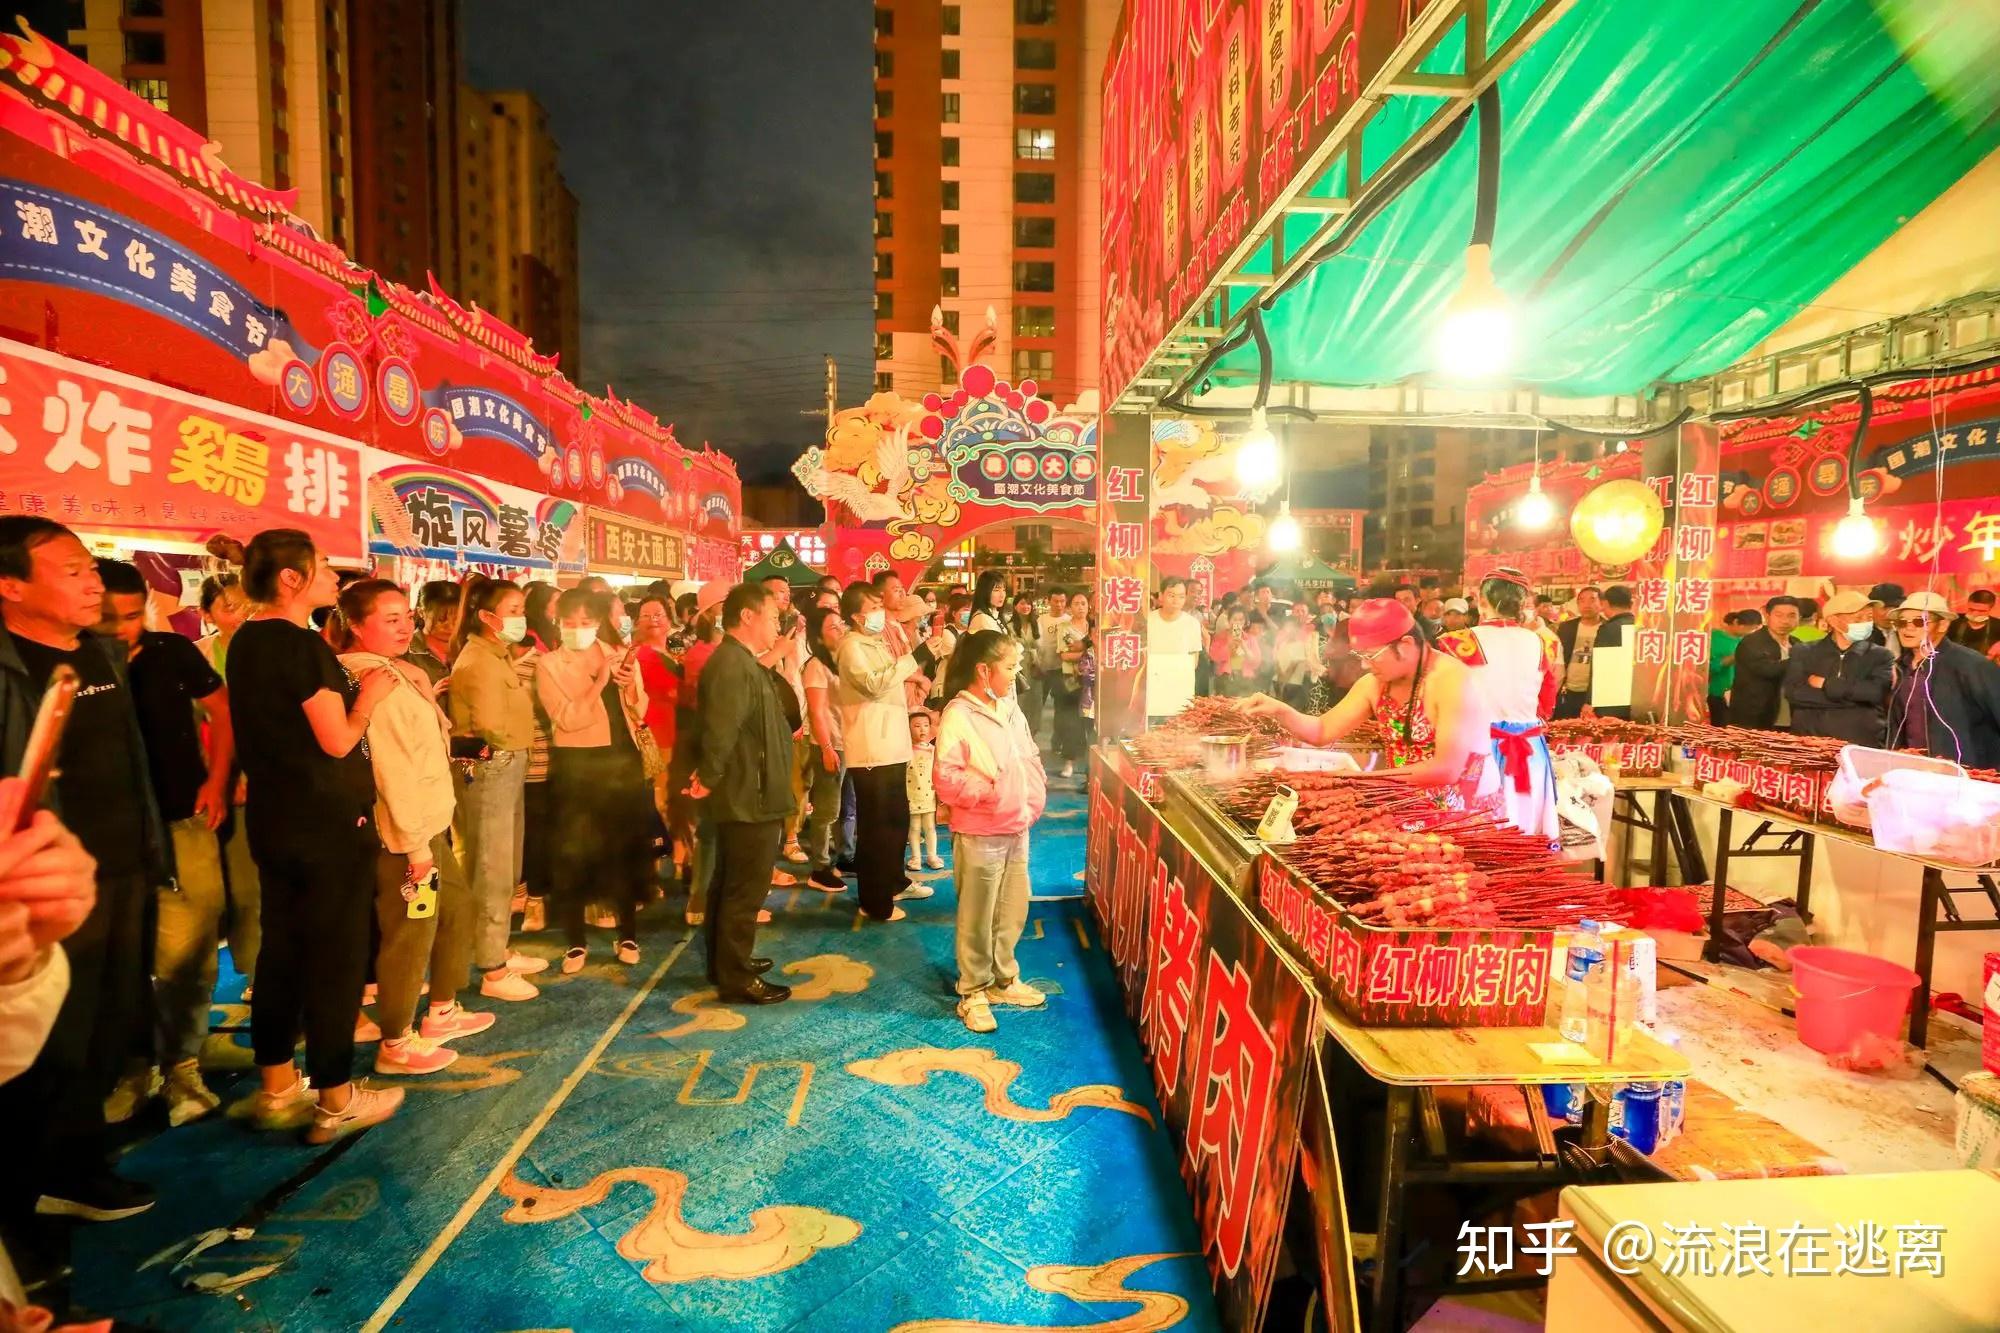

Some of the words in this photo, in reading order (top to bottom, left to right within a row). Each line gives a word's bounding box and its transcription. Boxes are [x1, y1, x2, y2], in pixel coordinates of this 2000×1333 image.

[0, 199, 268, 347] 潮文化美食节
[0, 364, 350, 519] 炸鷄排
[993, 482, 1086, 496] 國潮文化美食節
[1887, 428, 2000, 470] 国潮文化
[405, 486, 564, 562] 旋风薯塔
[605, 524, 677, 568] 西安大面筋
[1104, 465, 1145, 671] 红柳烤肉
[1673, 472, 1716, 666] 红柳烤肉
[1696, 753, 1815, 808] 红柳烤肉
[1260, 861, 1362, 998] 红柳烤肉
[1369, 943, 1549, 1007] 红柳烤肉
[1090, 776, 1277, 1280] 红柳烤肉
